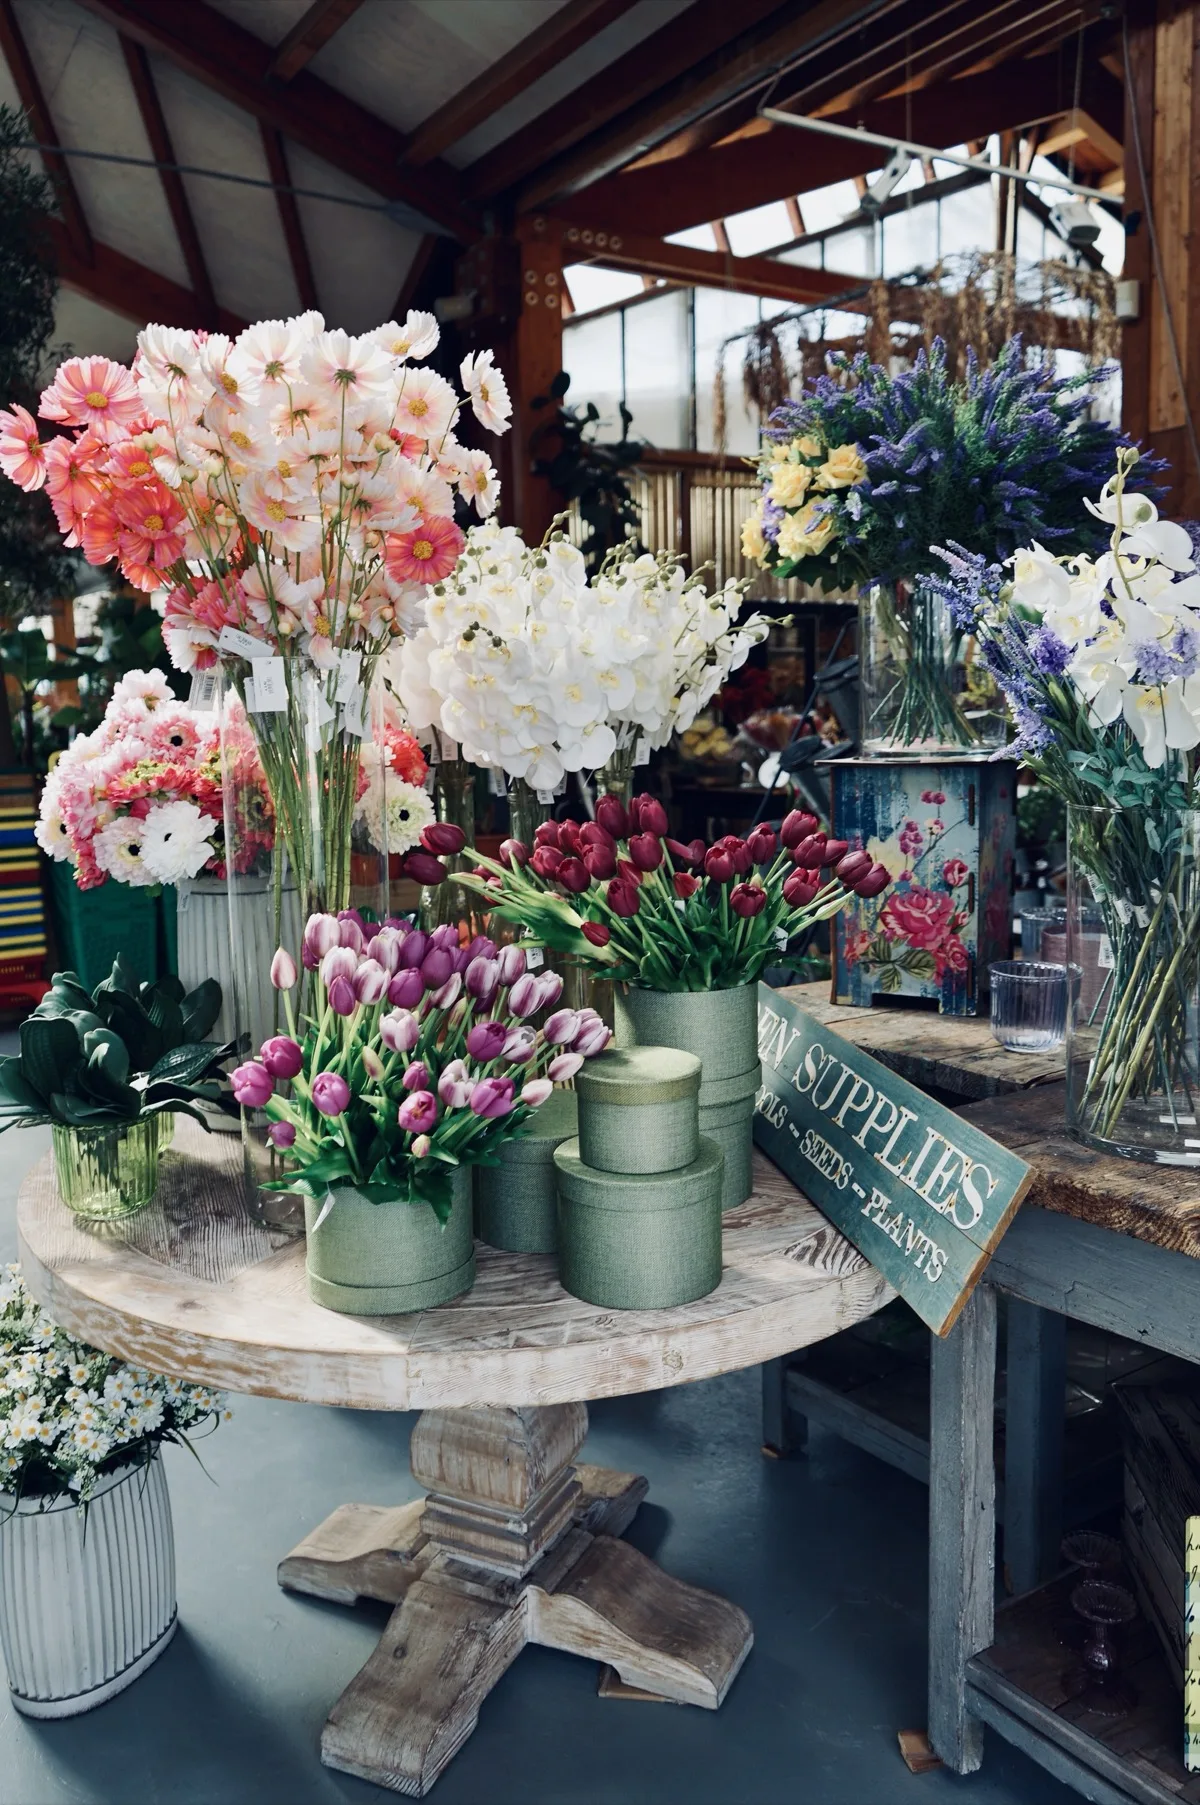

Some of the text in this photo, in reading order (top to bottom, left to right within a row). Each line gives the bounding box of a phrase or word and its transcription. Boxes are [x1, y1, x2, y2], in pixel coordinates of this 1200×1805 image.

[758, 1001, 999, 1230] EN SUPPLIES
[799, 1129, 854, 1190] SEEDS
[861, 1187, 949, 1283] PLANTS
